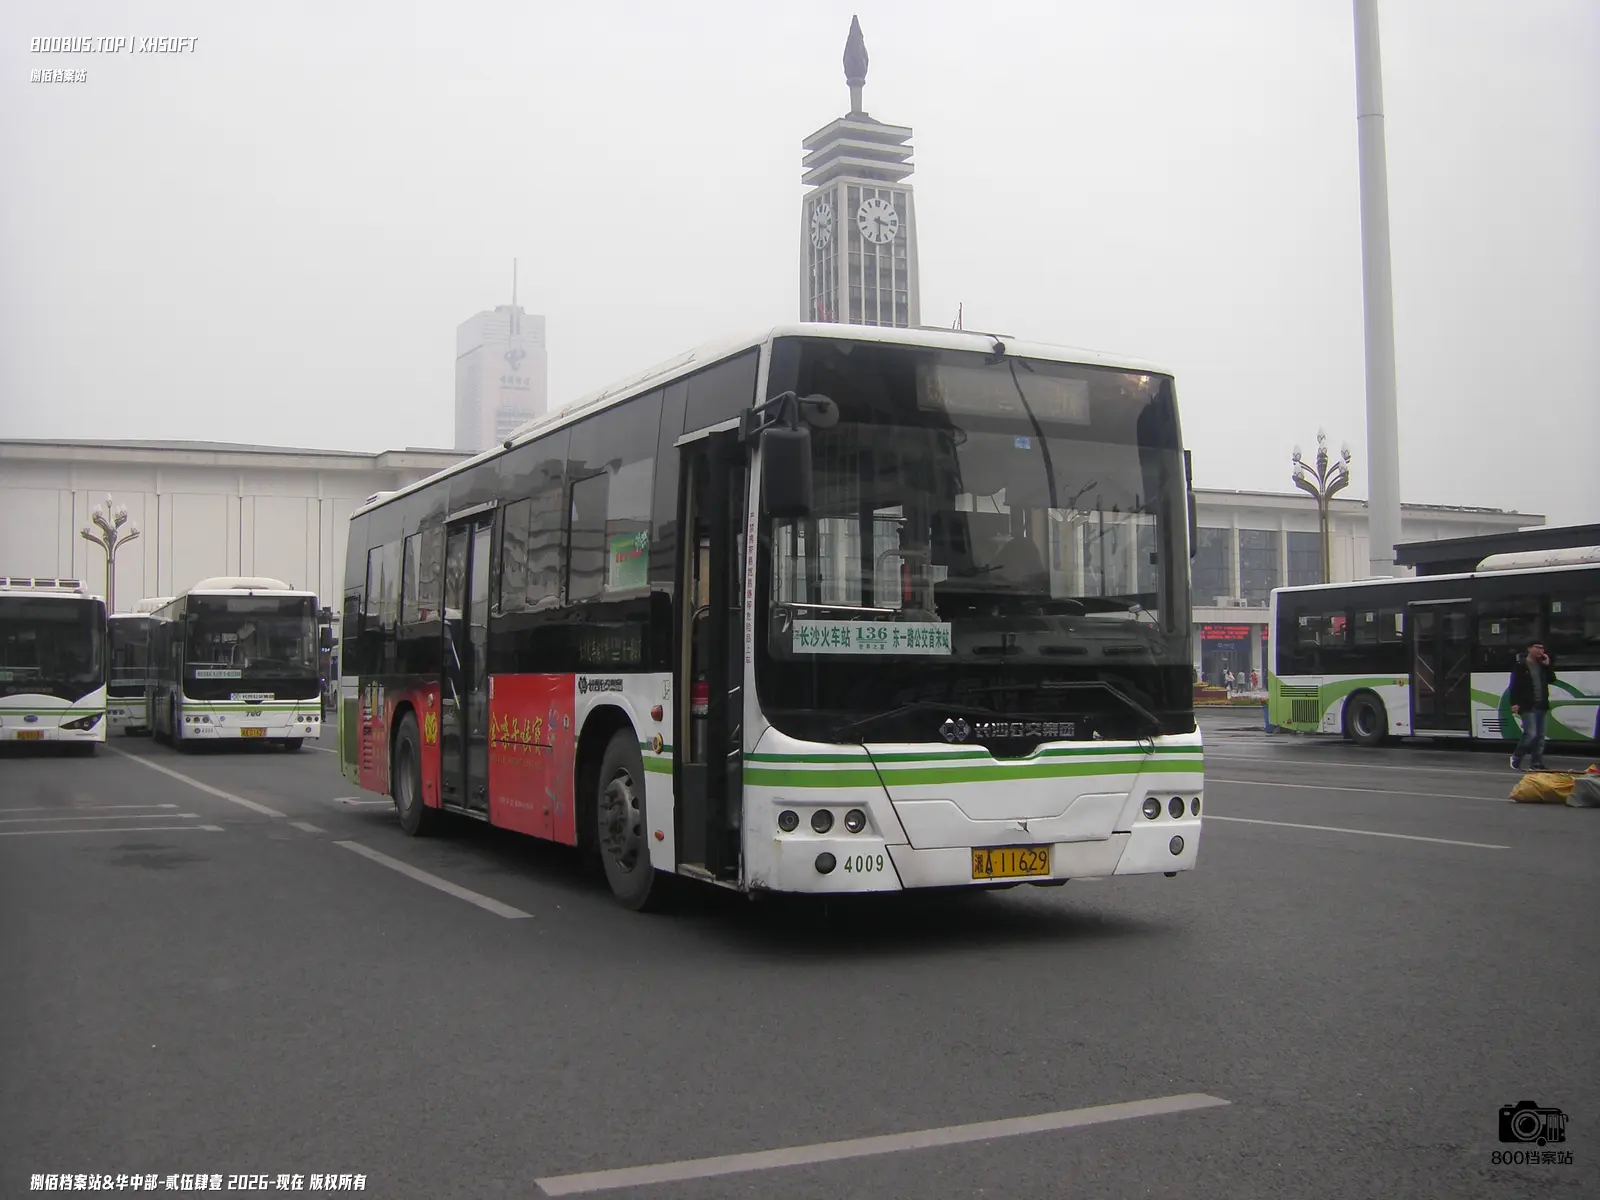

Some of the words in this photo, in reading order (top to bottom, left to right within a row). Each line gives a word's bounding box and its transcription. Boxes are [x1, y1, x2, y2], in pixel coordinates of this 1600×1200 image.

[799, 626, 850, 648] 长沙火车站
[856, 626, 888, 640] 136
[844, 854, 884, 873] 4009
